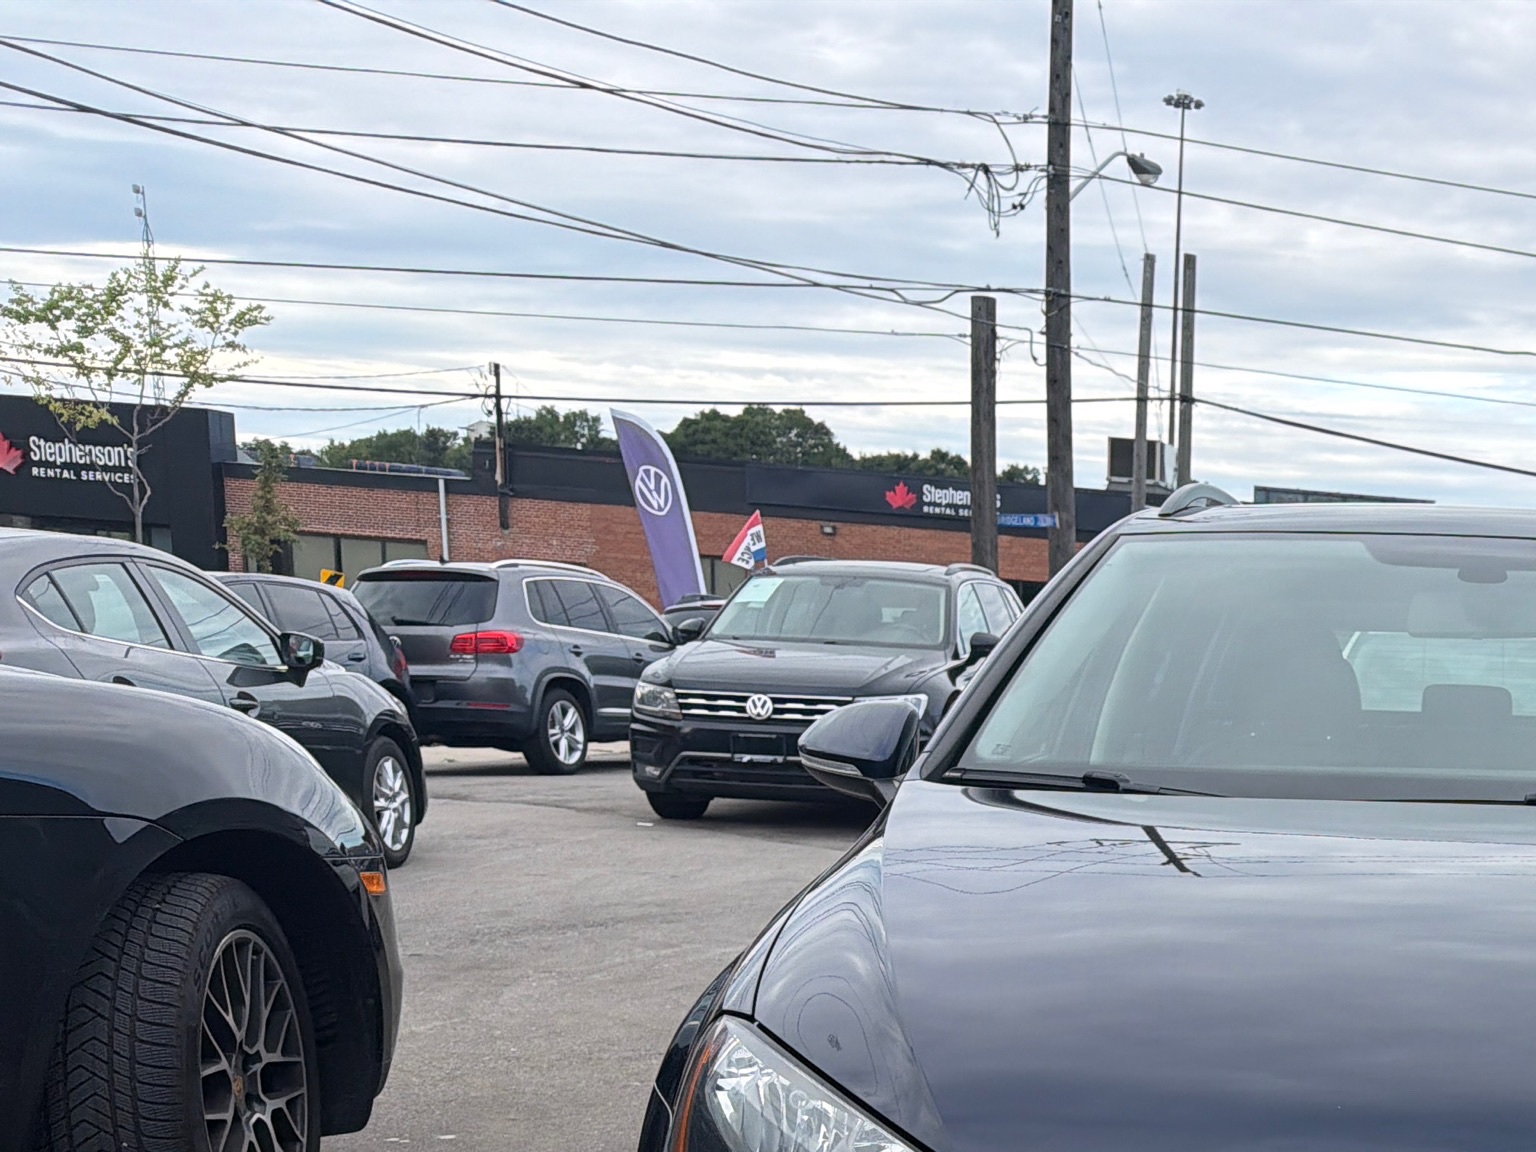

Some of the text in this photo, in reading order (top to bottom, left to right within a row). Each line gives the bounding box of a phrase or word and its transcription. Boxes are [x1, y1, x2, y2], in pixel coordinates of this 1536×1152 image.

[29, 435, 135, 468] Stephenson's
[31, 466, 77, 480] RENTAL
[922, 505, 956, 516] RENTAL
